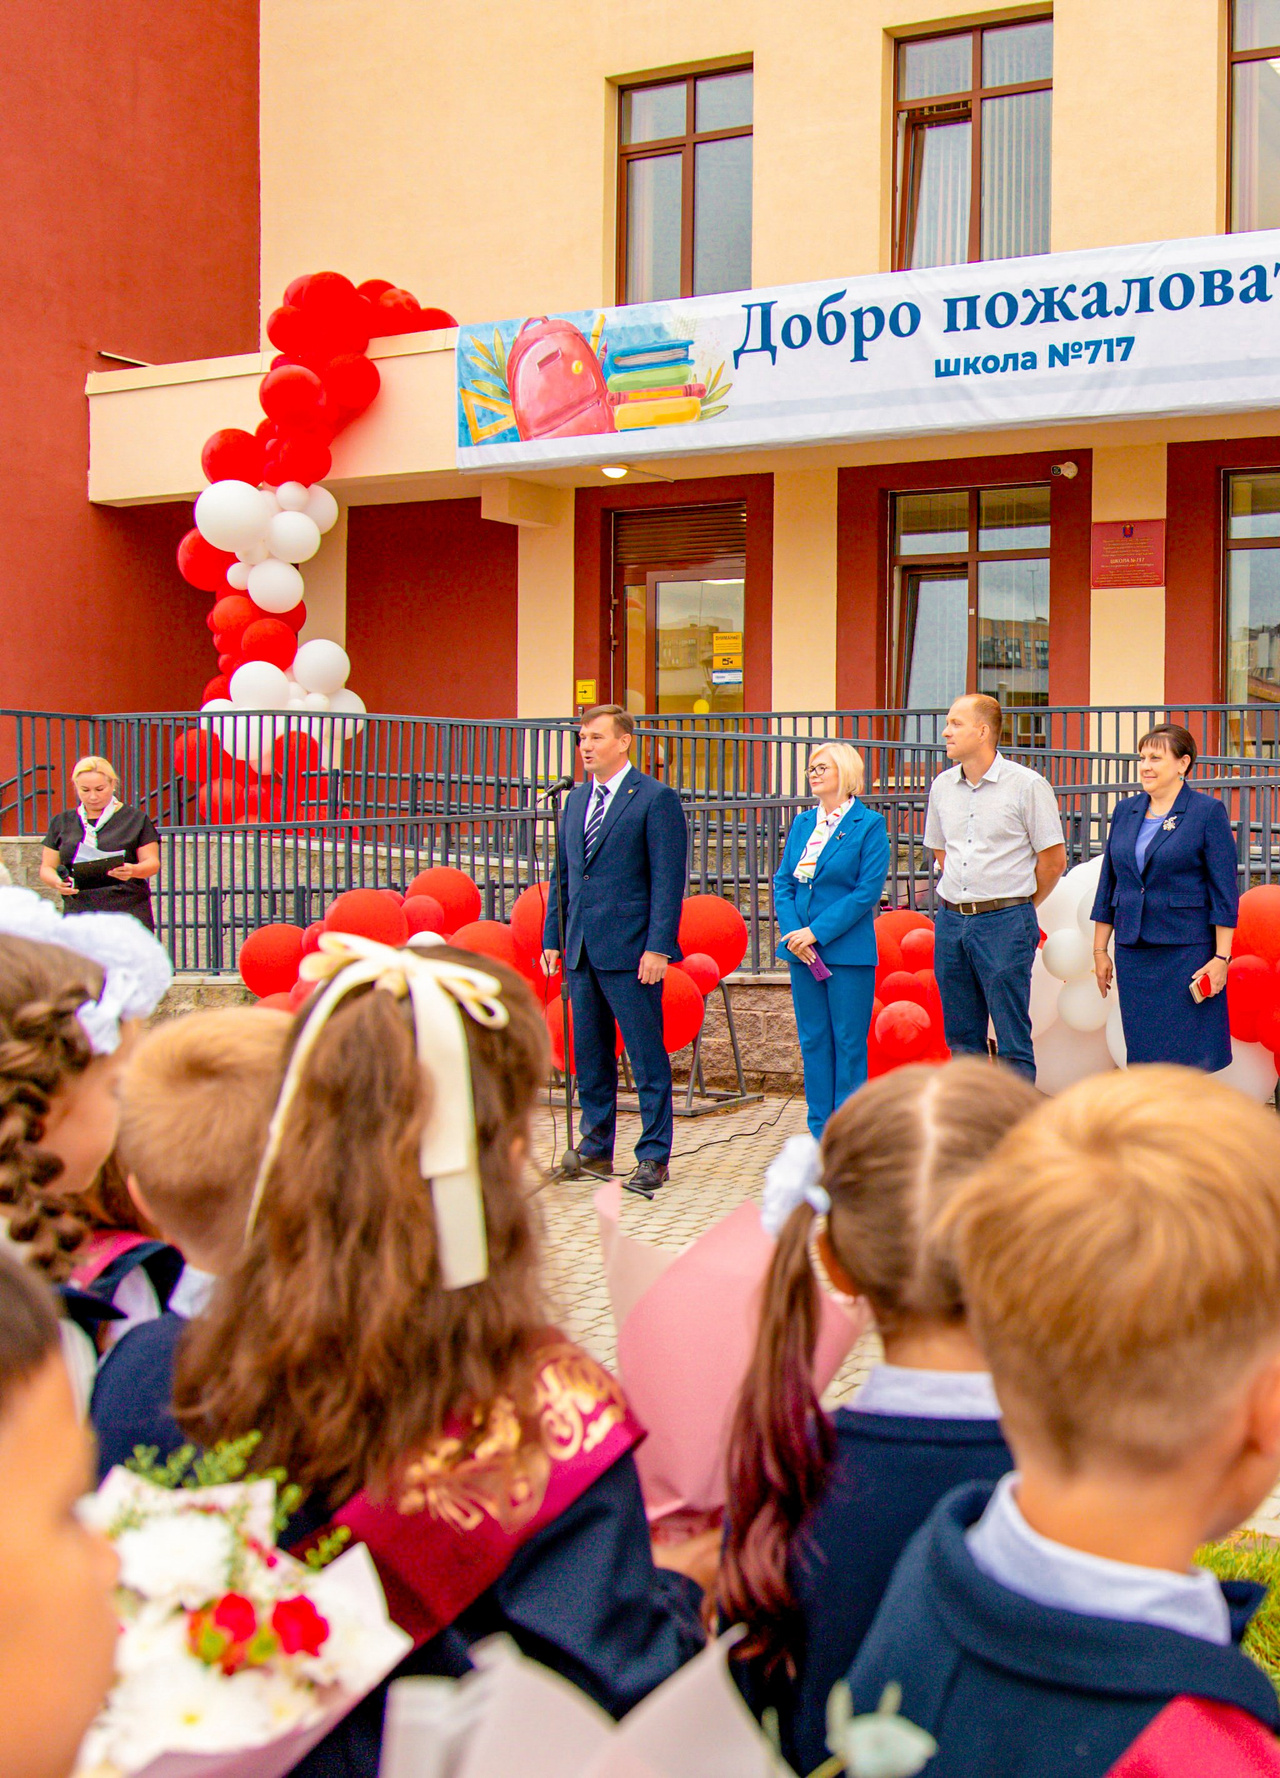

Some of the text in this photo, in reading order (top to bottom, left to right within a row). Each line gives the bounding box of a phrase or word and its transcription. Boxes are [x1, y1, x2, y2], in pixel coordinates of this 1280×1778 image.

[732, 289, 921, 370] Добро
[934, 335, 1137, 379] школа №717
